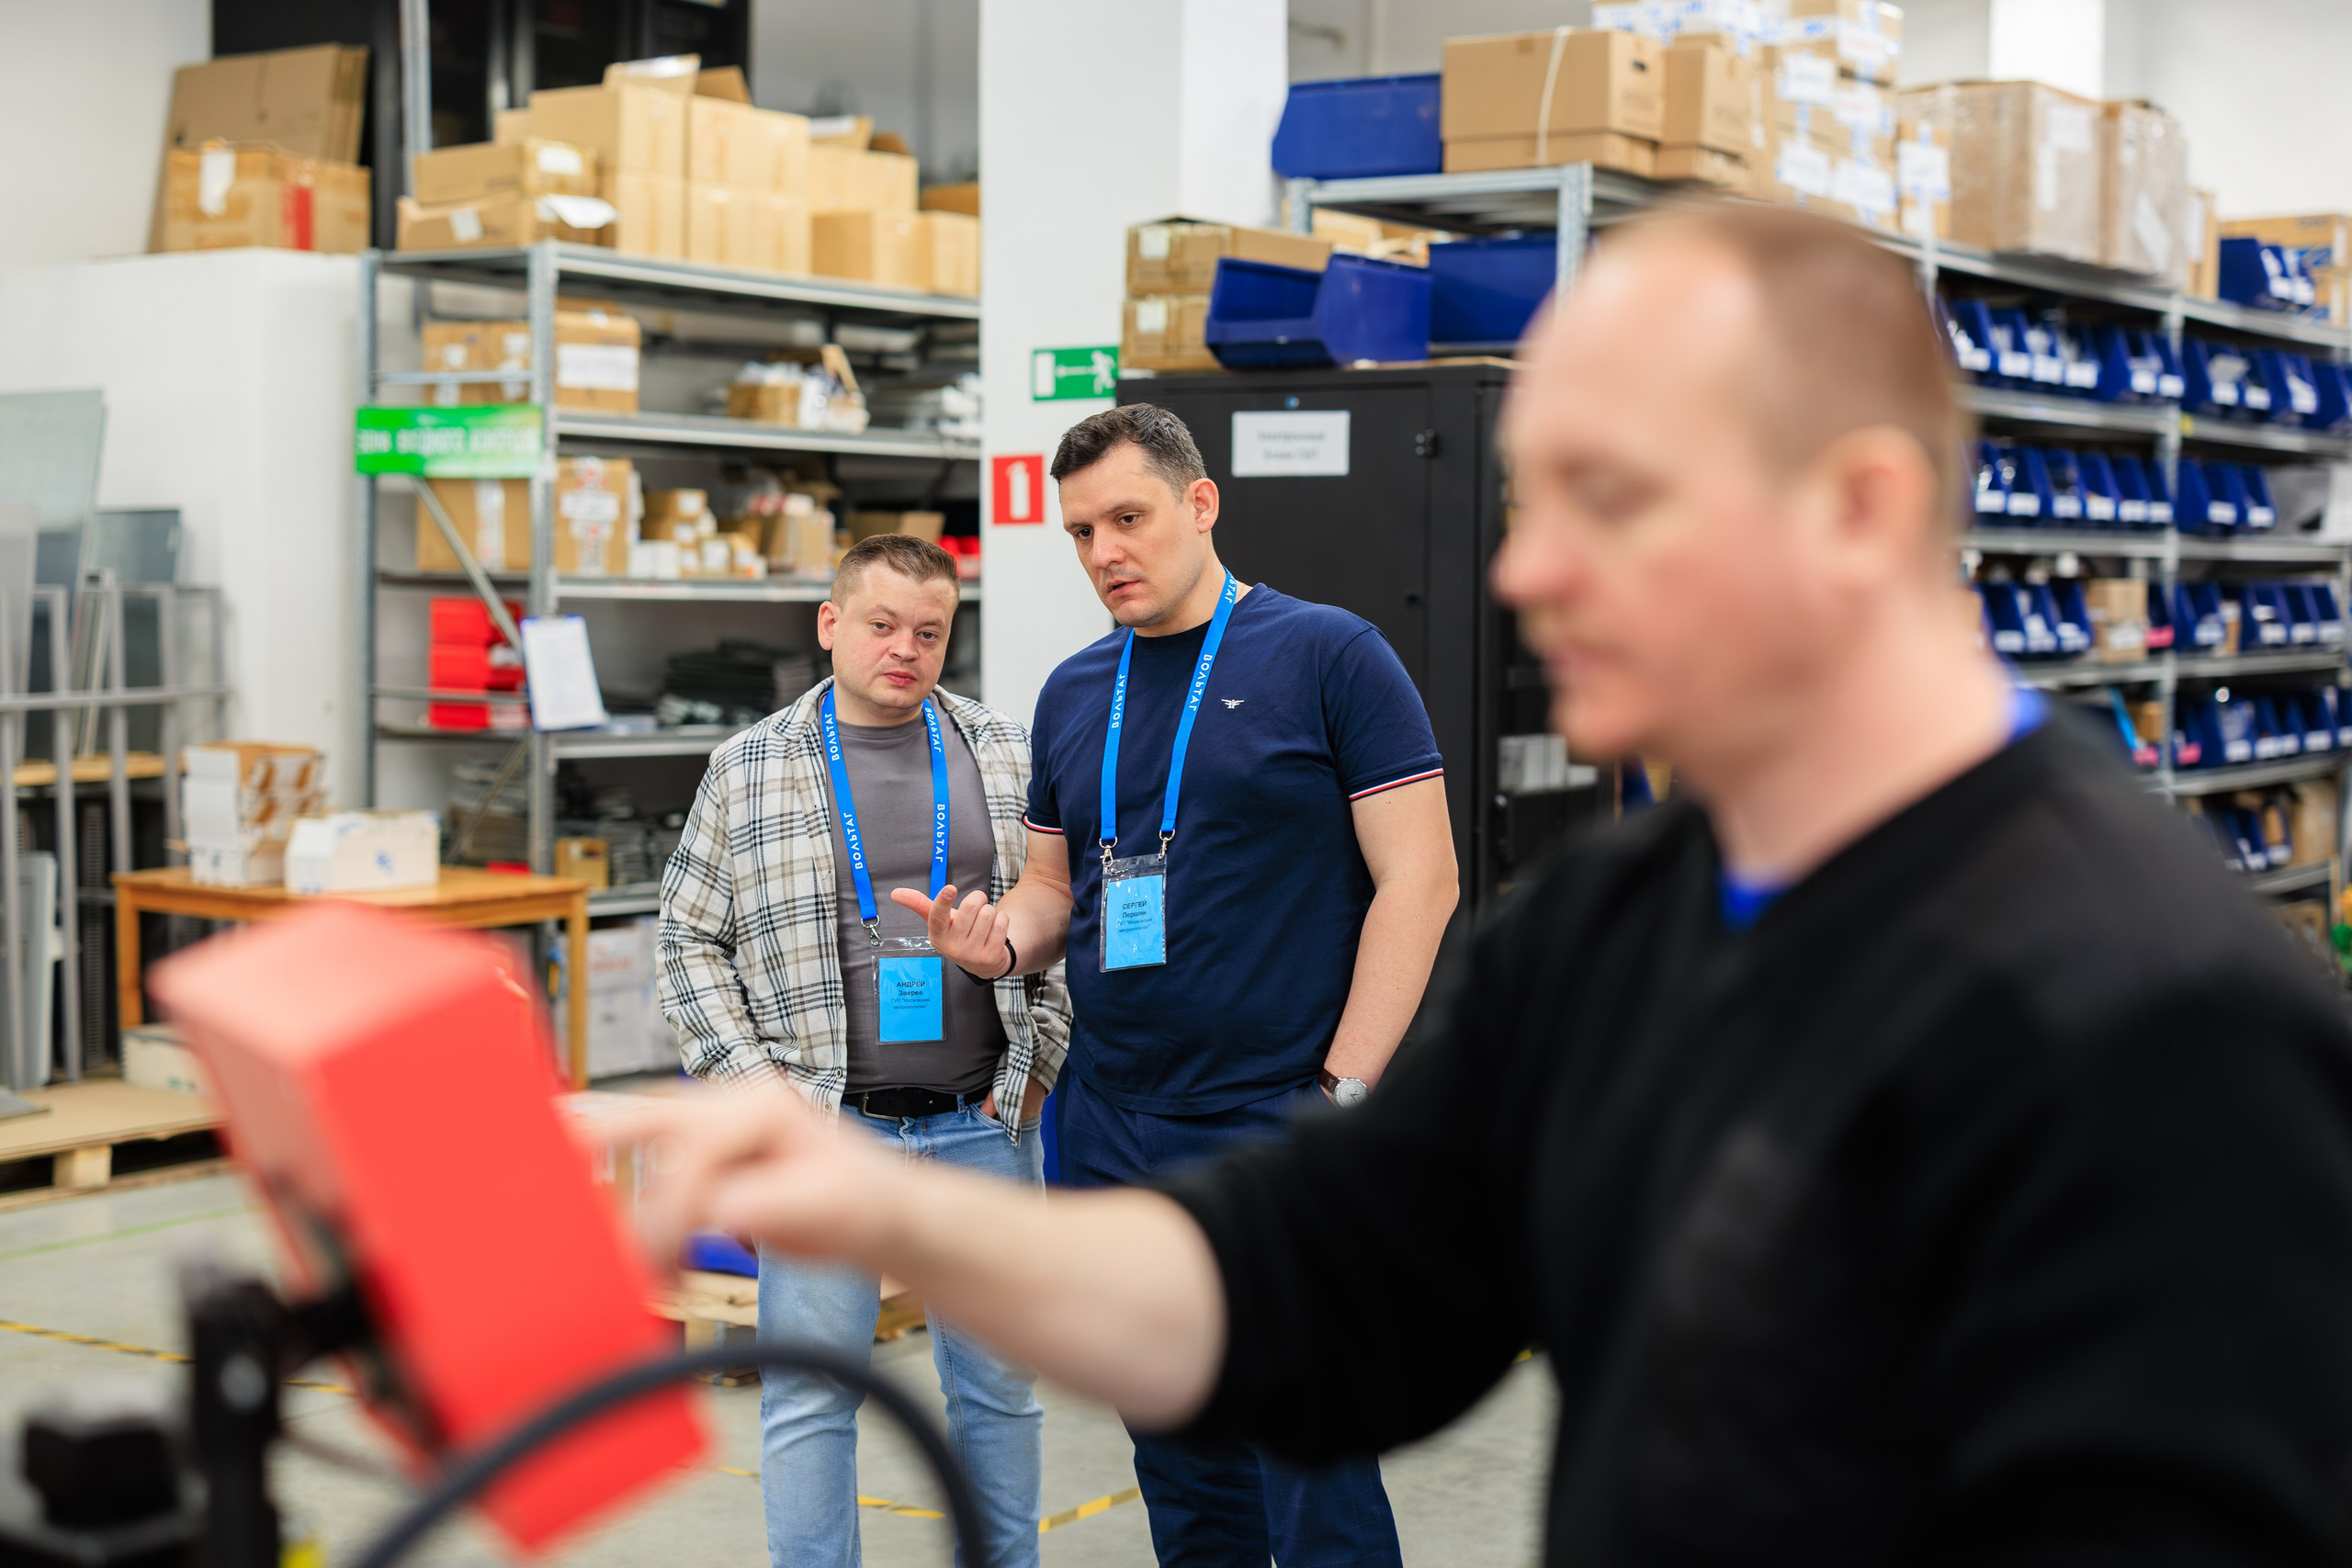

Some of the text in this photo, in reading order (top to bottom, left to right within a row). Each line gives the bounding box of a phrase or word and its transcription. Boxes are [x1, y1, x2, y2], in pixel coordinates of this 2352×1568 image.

[1111, 674, 1126, 728] ВОЛЬТАГ
[1189, 654, 1213, 712] ВОЛЬТАГ
[824, 713, 841, 761] ВОЛЬТАГ
[924, 706, 942, 752] ВОЛЬТАГ
[843, 812, 864, 870] ВОЛЬТАГ
[935, 804, 945, 863] ВОЛЬТАГ
[1122, 900, 1148, 909] СЕРГЕЙ
